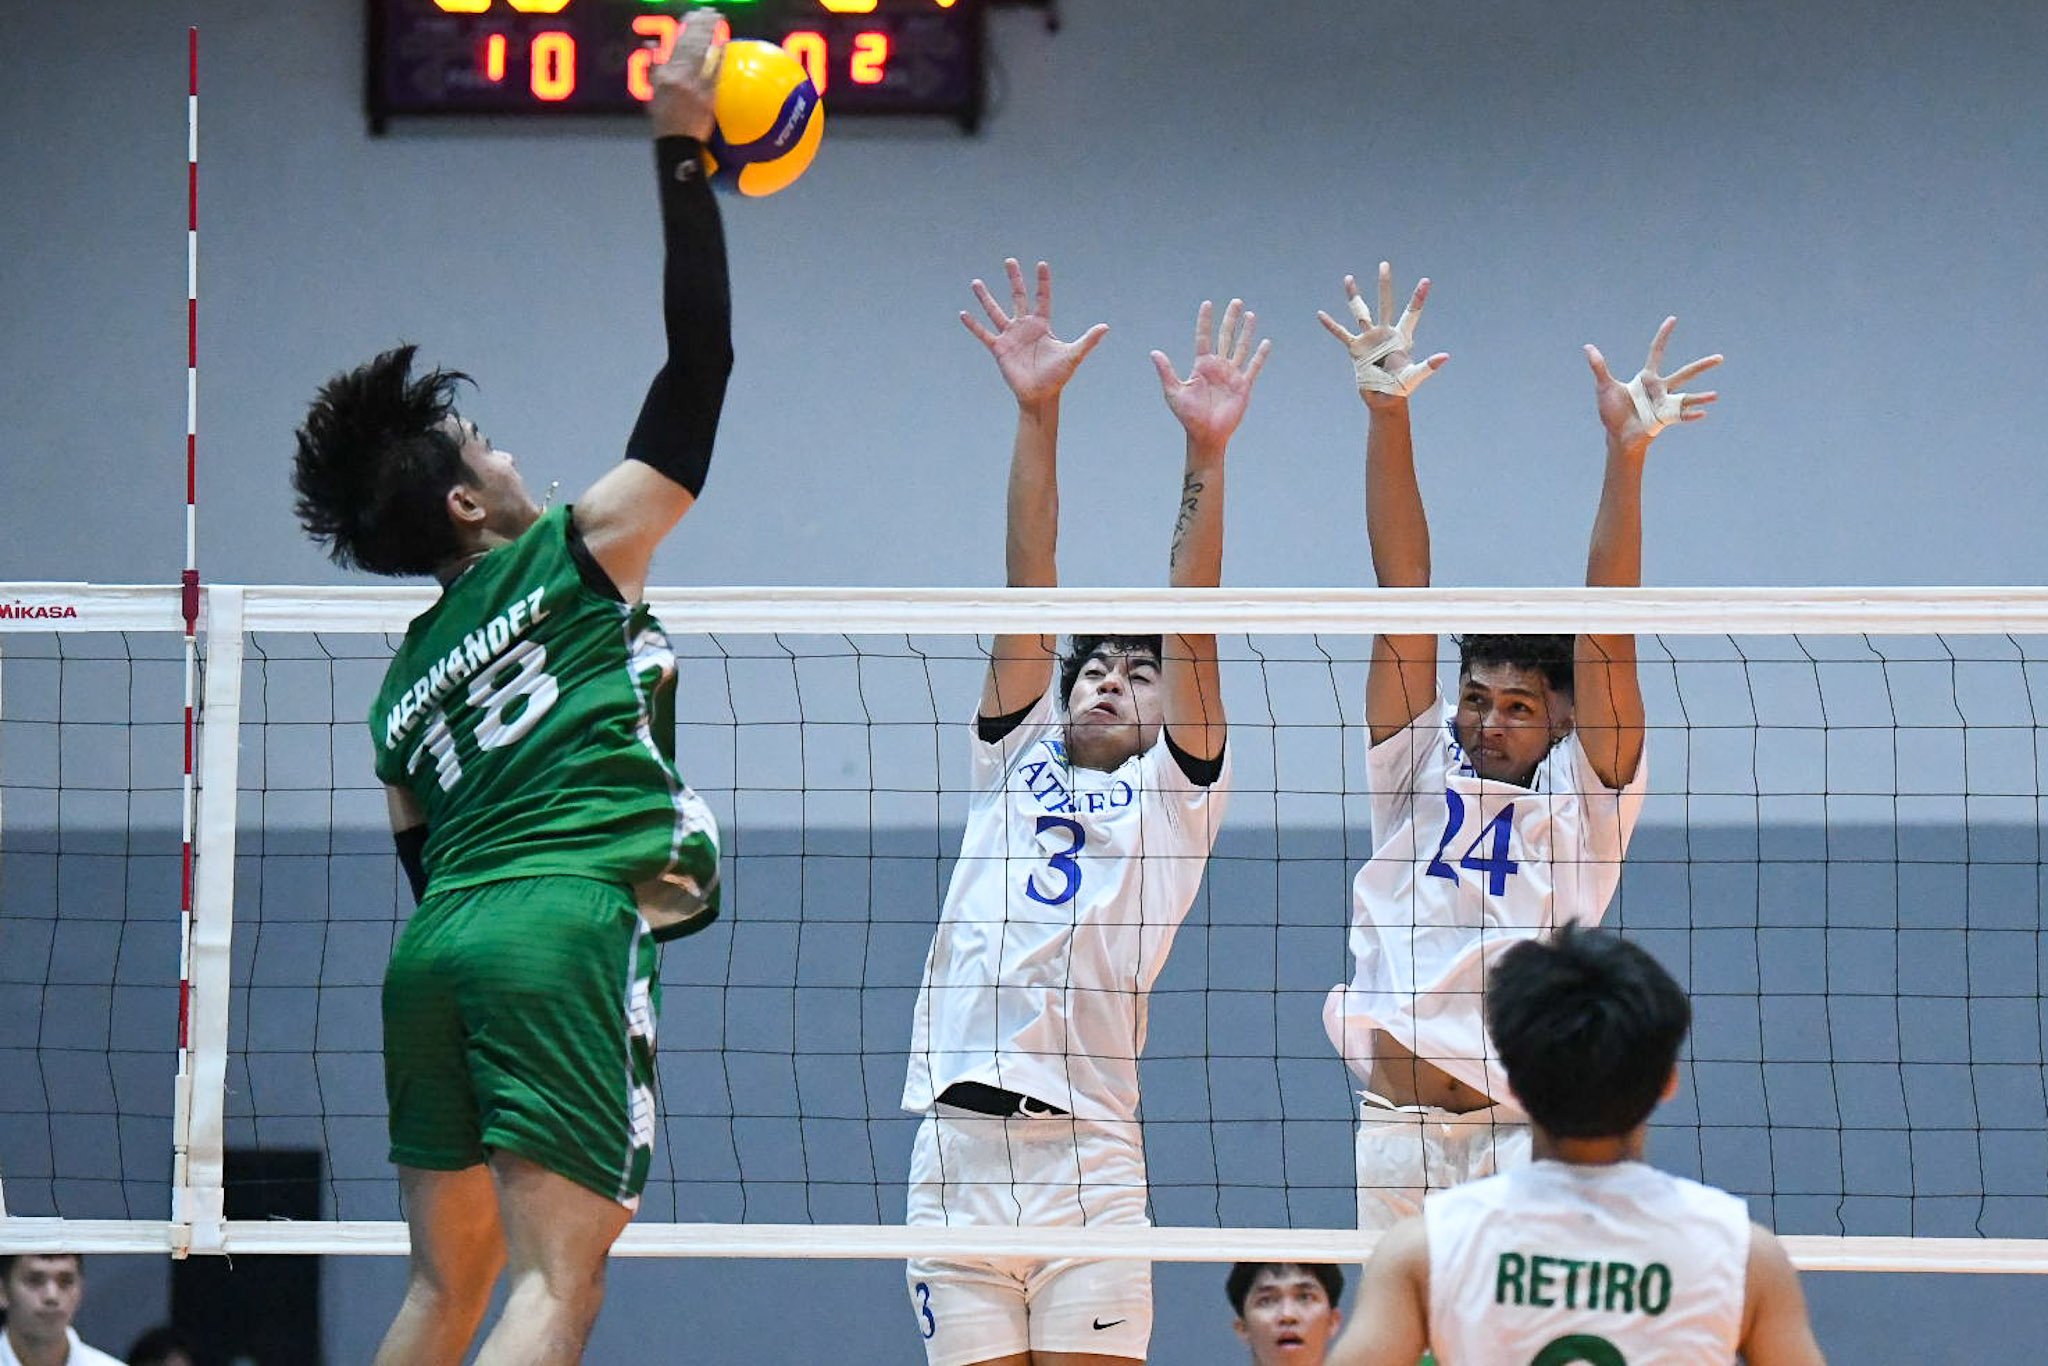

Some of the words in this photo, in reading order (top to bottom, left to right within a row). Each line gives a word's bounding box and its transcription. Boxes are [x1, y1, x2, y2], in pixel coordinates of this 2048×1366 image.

[851, 32, 888, 84] 2
[385, 586, 551, 750] HERNANDEZ
[407, 639, 560, 793] 18
[1018, 761, 1134, 814] ATEO
[1025, 815, 1086, 906] 3
[1426, 787, 1519, 897] 24
[915, 1282, 936, 1340] 3
[1495, 1252, 1673, 1317] RETIRO
